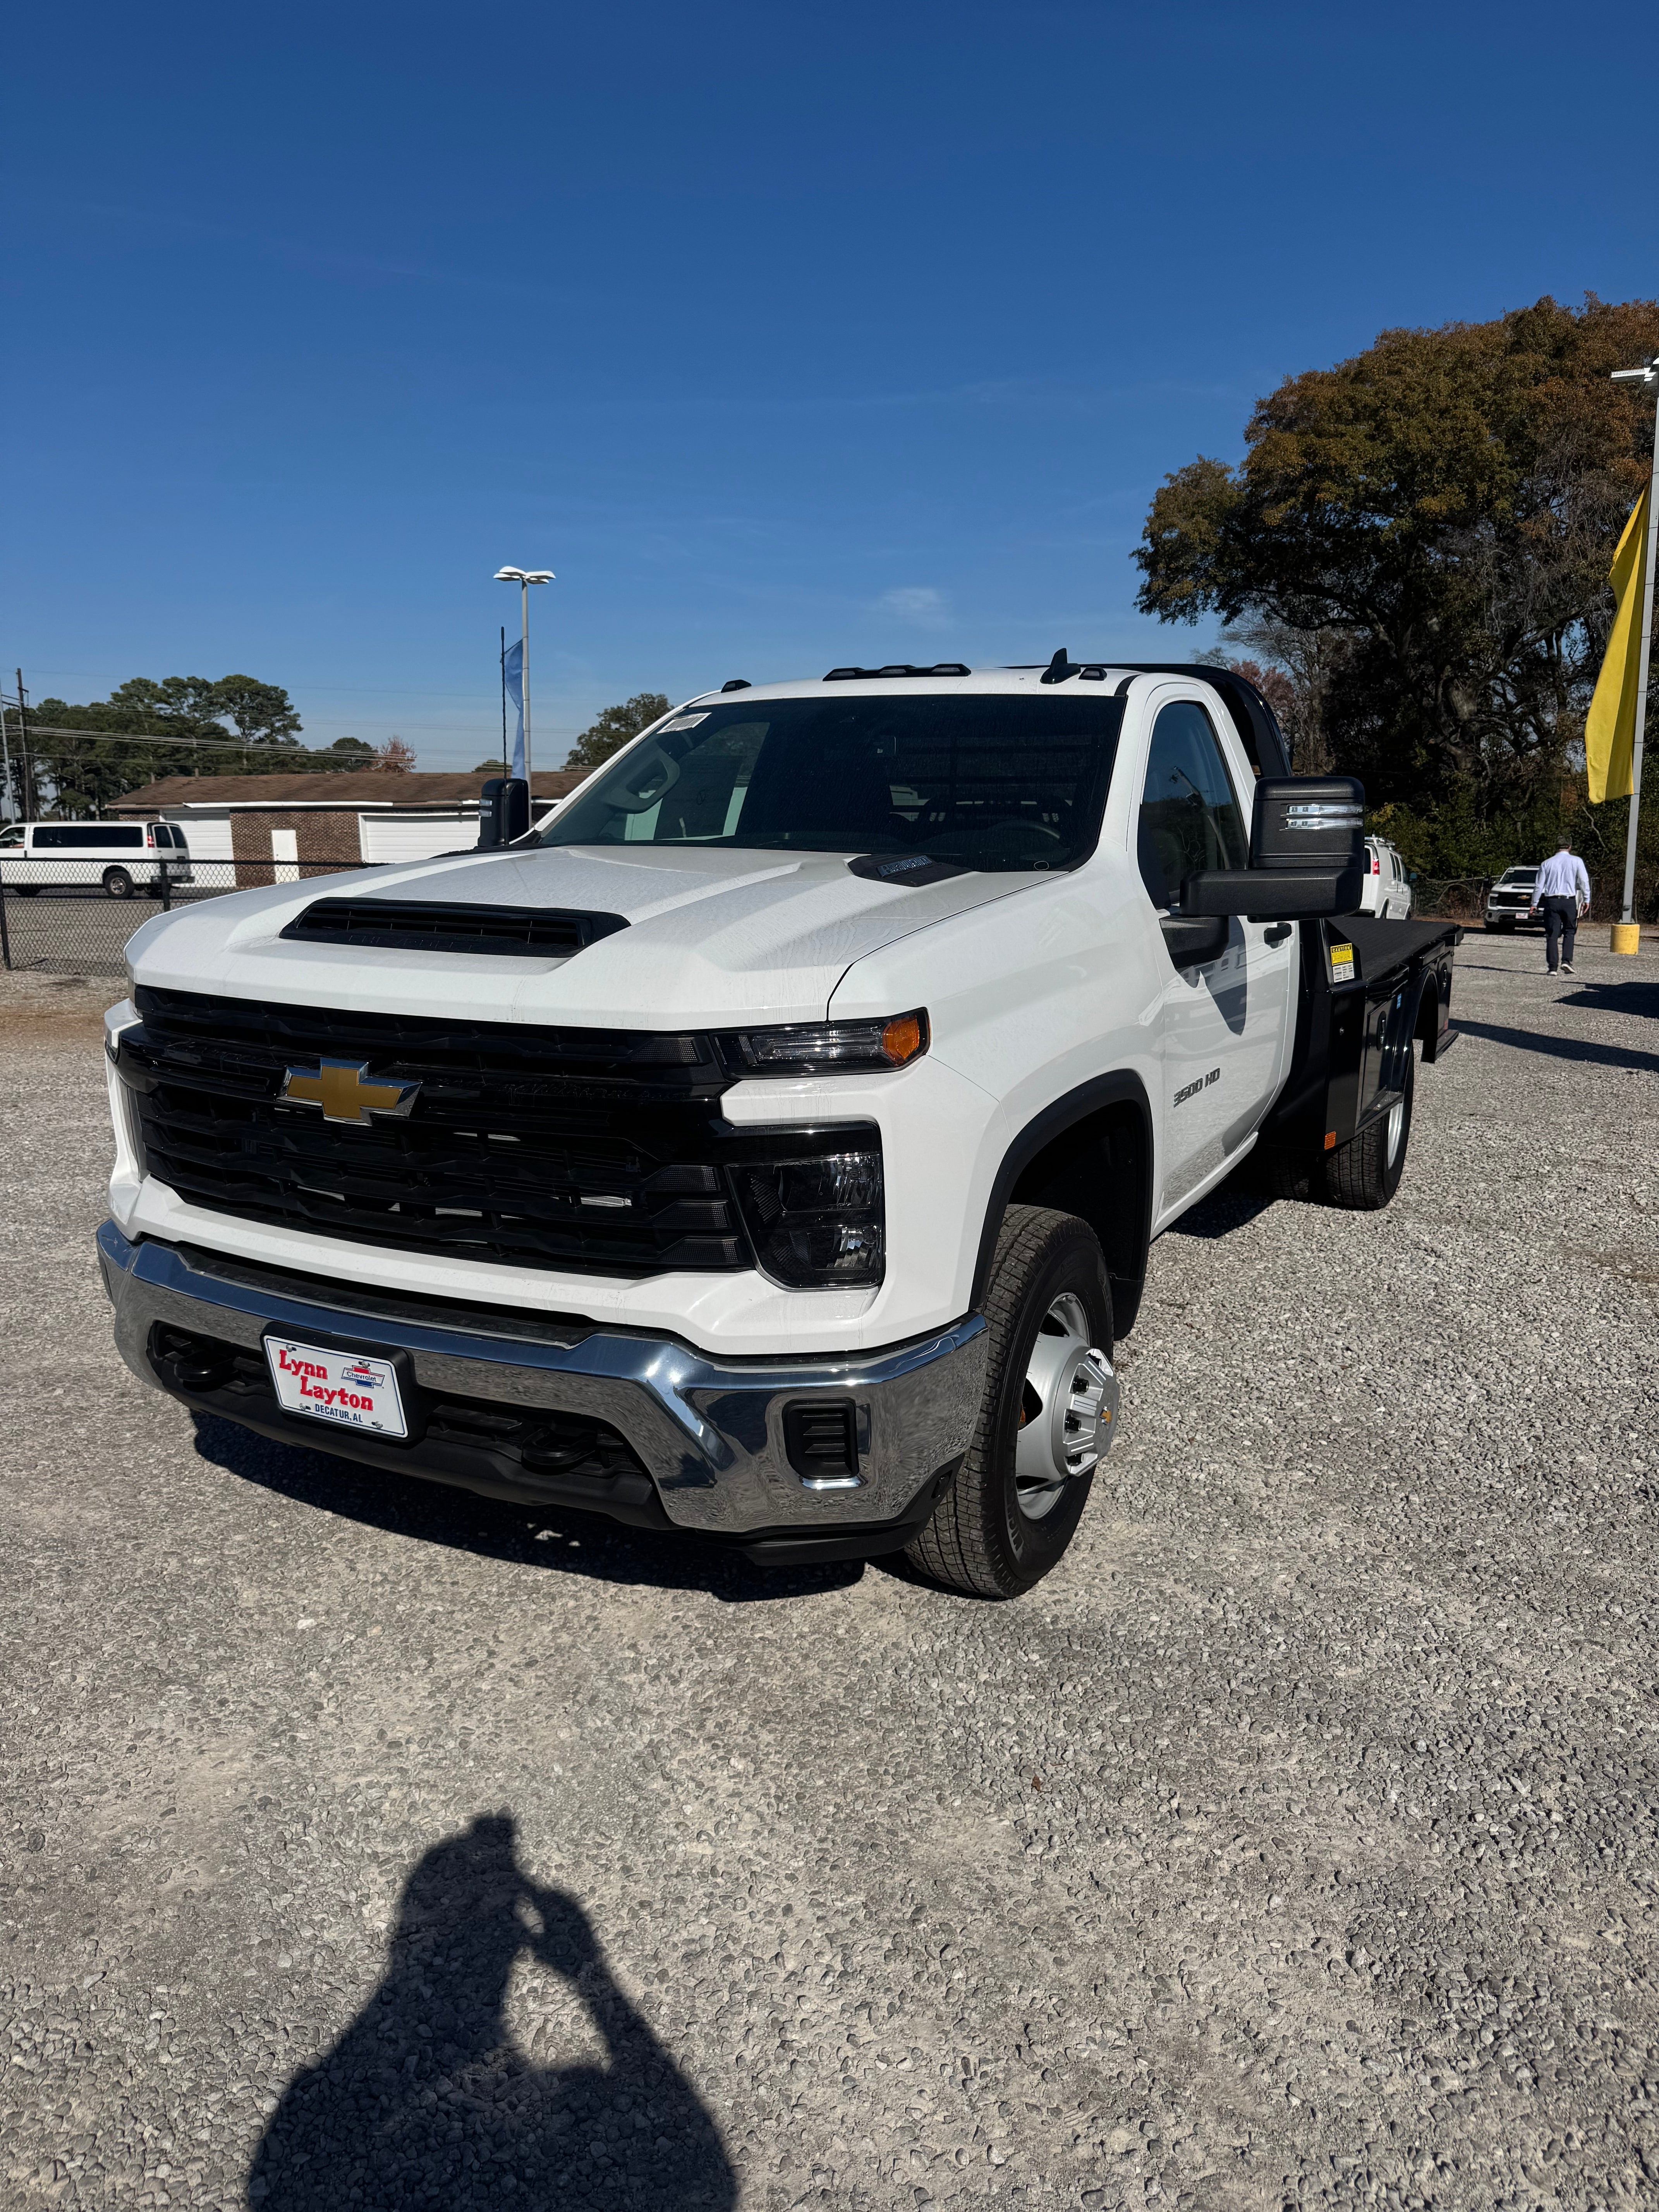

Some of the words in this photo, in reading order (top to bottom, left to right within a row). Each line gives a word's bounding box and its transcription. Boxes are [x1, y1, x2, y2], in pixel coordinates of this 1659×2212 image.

[1173, 1078, 1203, 1108] 3500
[1205, 1068, 1220, 1088] HD
[279, 1349, 328, 1379] Lynn
[347, 1370, 376, 1382] Chevrolet
[300, 1375, 374, 1411] Layton
